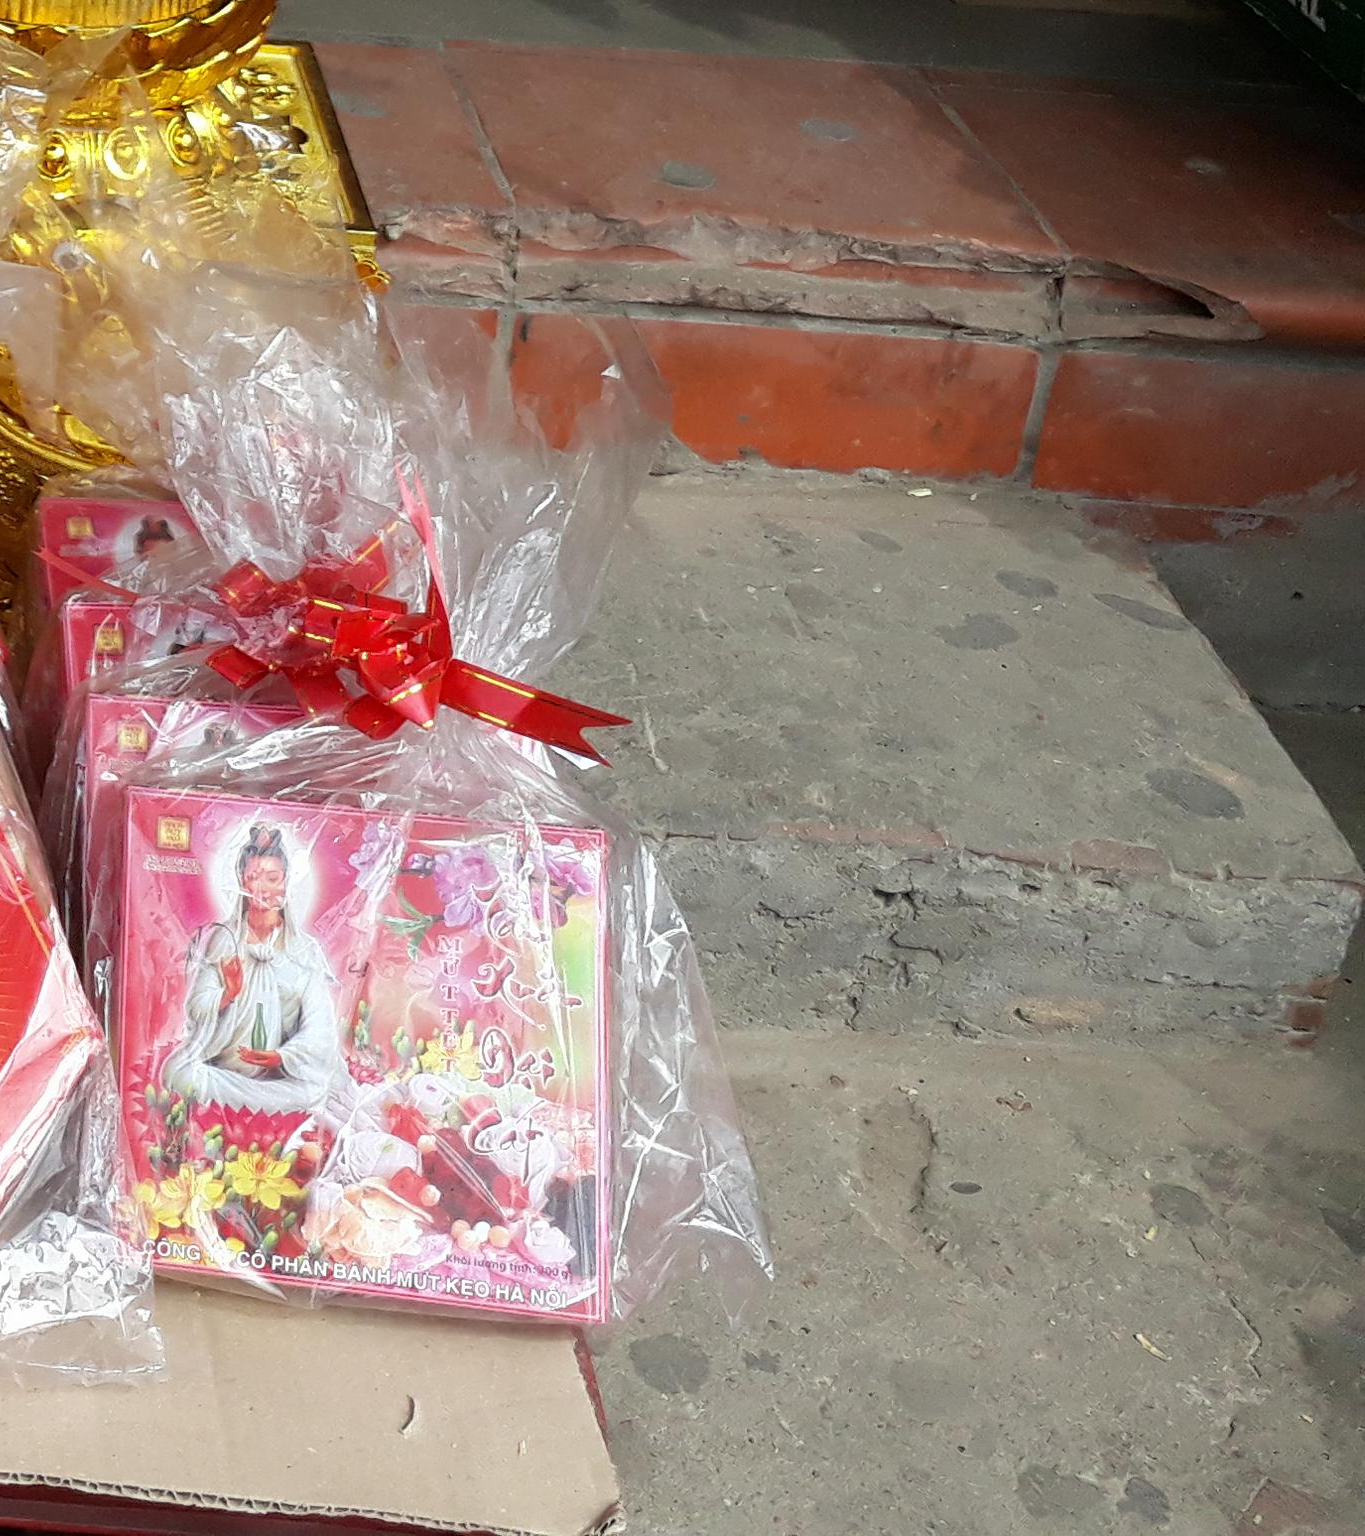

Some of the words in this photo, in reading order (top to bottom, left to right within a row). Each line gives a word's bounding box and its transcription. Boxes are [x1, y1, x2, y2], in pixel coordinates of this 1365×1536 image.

[143, 1238, 201, 1263] CÔNG
[270, 1251, 329, 1278] PHẦN
[333, 1259, 391, 1287] BÁNH
[395, 1268, 442, 1293] MỨT
[445, 1275, 492, 1302] KẸO
[495, 1276, 526, 1304] HÀ
[529, 1279, 568, 1310] NỘI
